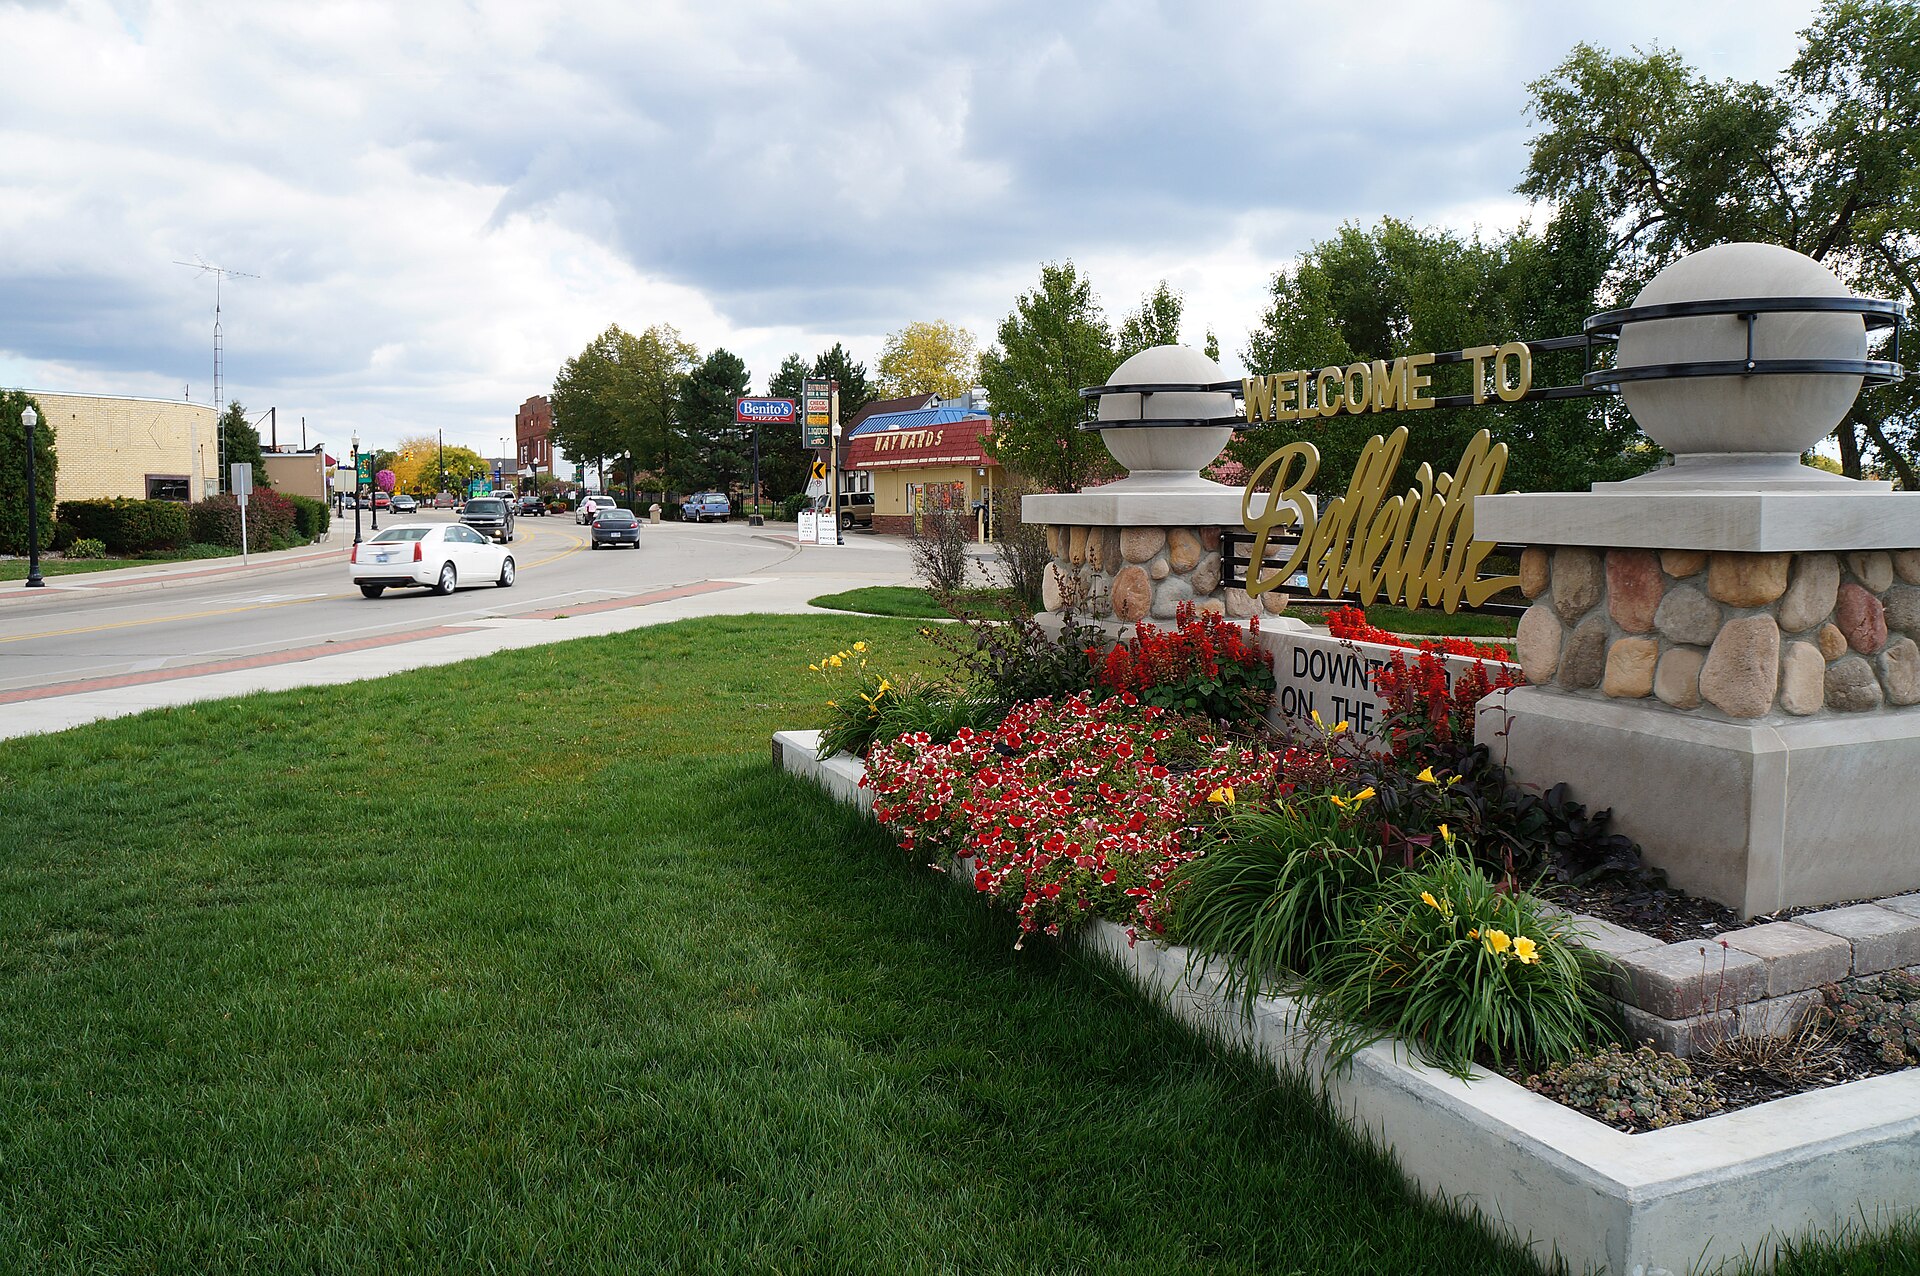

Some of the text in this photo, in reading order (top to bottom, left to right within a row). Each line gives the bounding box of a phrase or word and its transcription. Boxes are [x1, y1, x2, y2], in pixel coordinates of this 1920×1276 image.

[1242, 342, 1532, 423] WELCOME TO
[743, 402, 789, 415] Benito's
[808, 427, 829, 435] LIQUOR
[874, 430, 944, 452] HAYWARDS
[1281, 685, 1376, 736] ON THE
